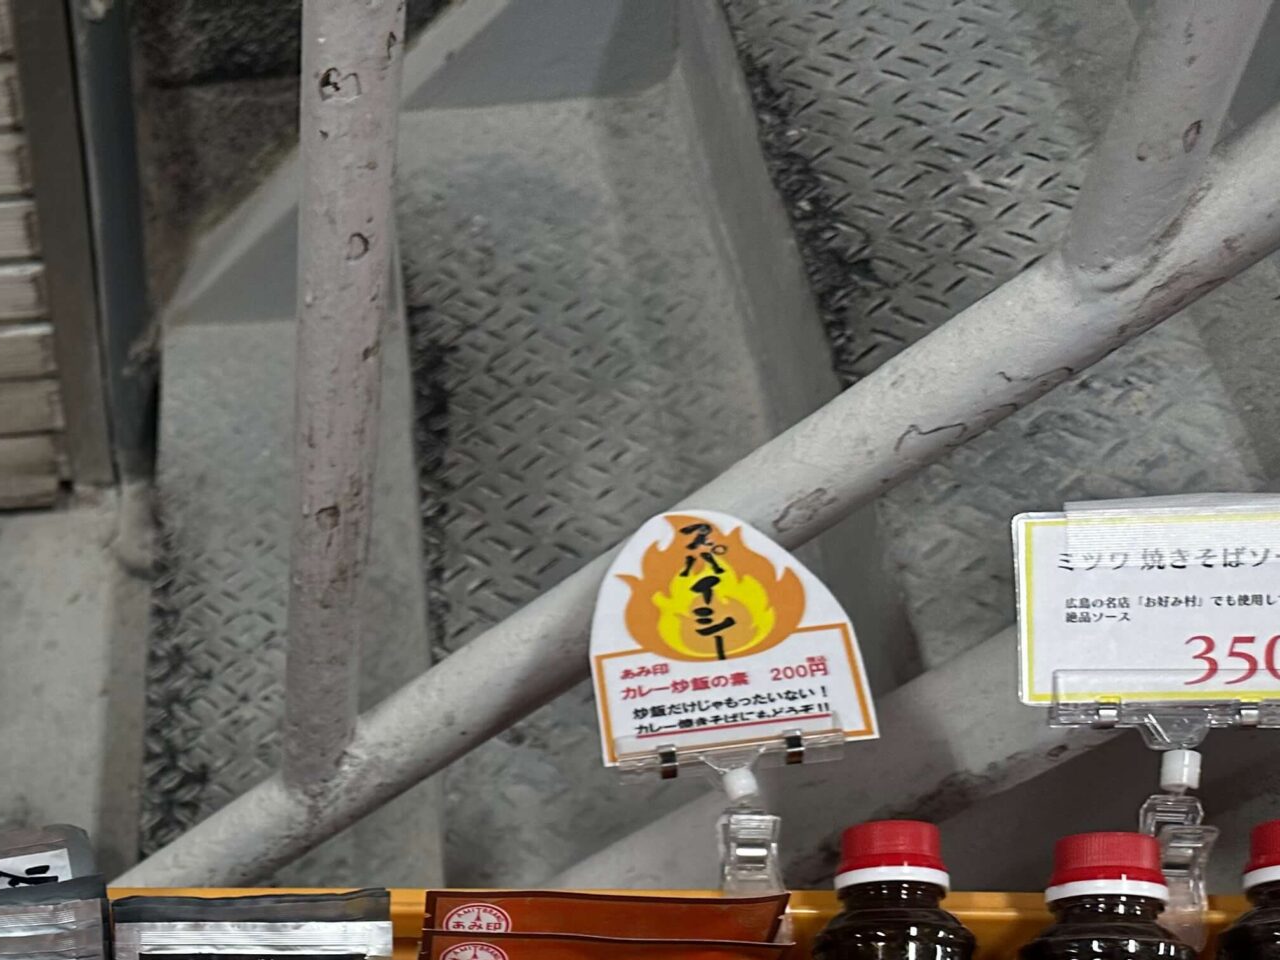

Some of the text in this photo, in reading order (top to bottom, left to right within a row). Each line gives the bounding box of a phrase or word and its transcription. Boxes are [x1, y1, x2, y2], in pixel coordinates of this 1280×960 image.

[1057, 547, 1280, 571] ミツワ 焼きそばソ
[1066, 611, 1131, 623] 絶品ソース
[620, 663, 670, 681] あみ印
[621, 671, 750, 701] カレー炒飯の素
[452, 921, 502, 931] あみ印
